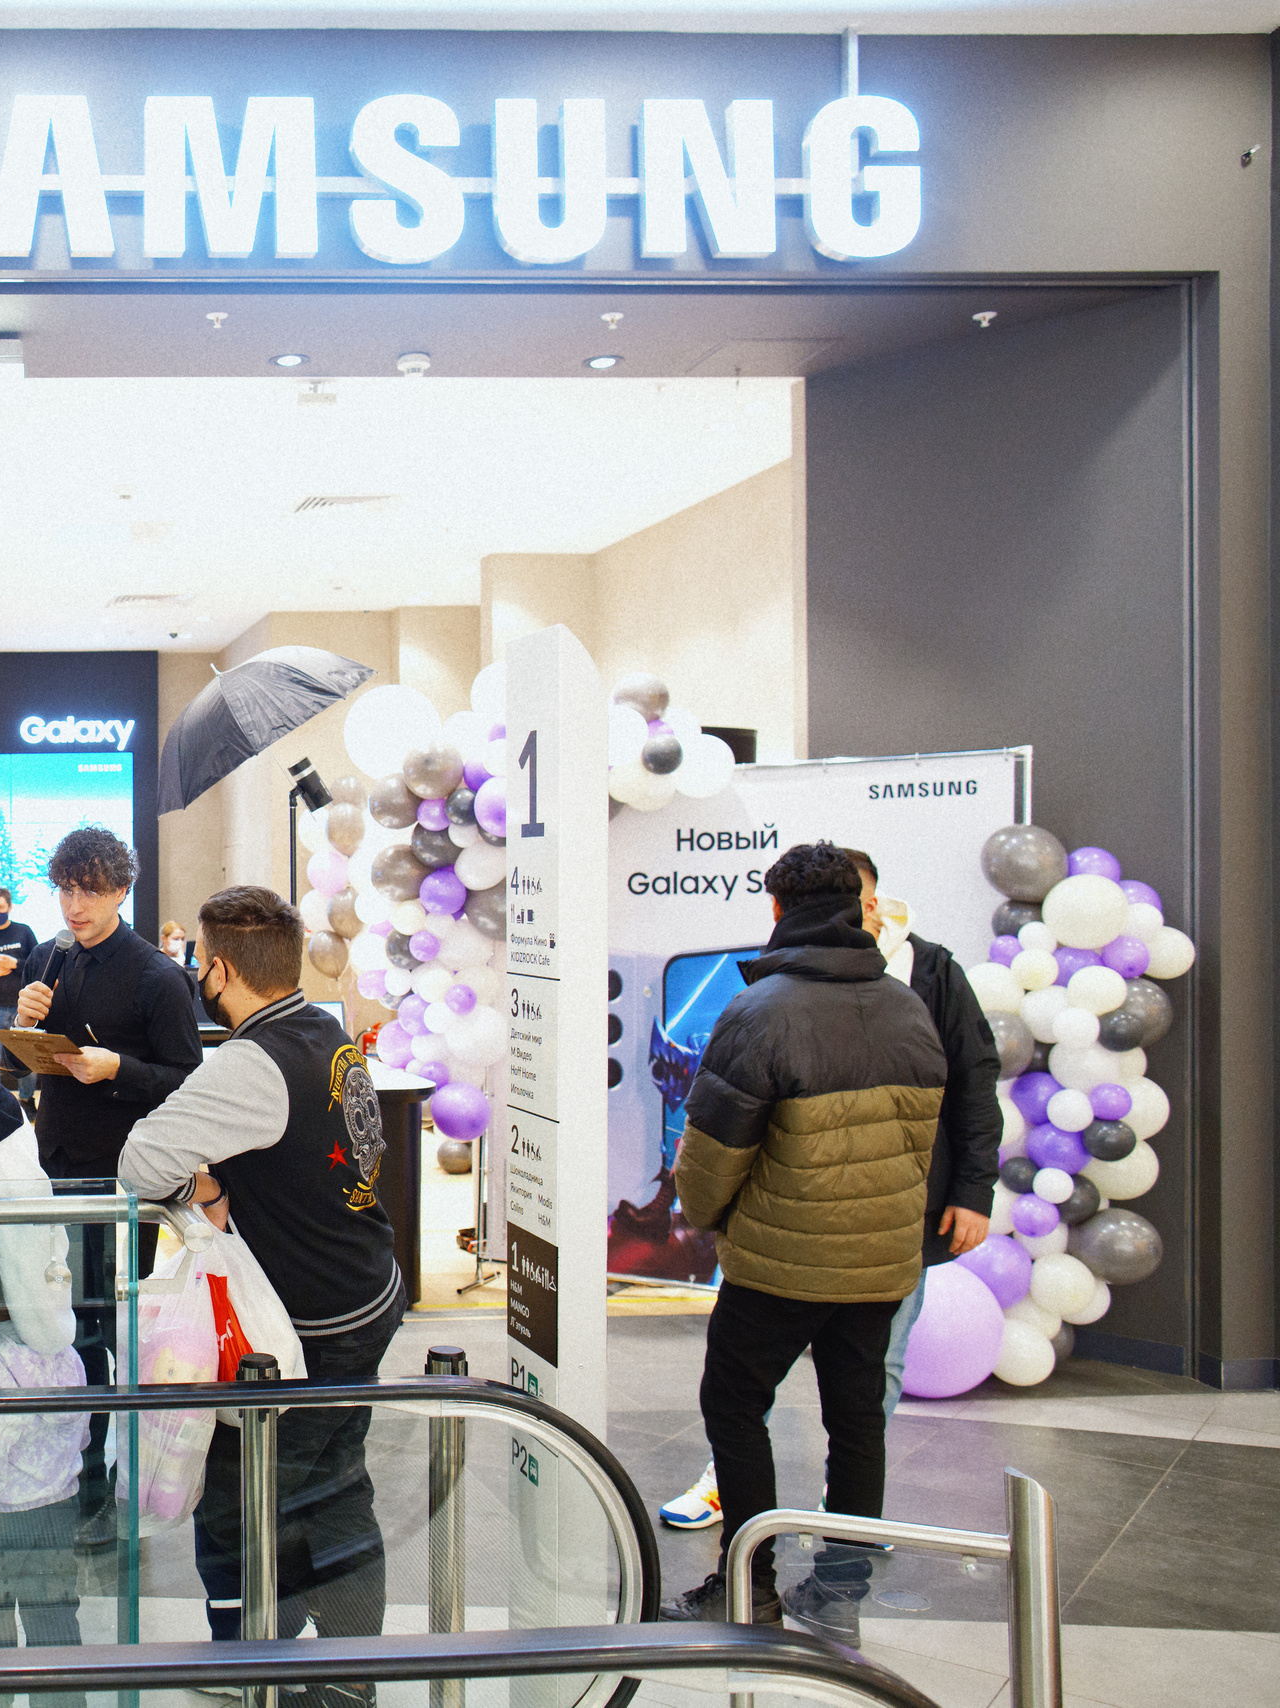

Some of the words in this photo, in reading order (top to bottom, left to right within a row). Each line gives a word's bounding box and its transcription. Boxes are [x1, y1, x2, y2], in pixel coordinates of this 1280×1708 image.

[19, 715, 135, 751] Galaxy
[77, 763, 123, 772] SAMSUNG
[518, 730, 545, 838] 1
[868, 779, 979, 800] SAMSUNG
[675, 822, 779, 852] Новый
[510, 866, 520, 895] 4
[627, 870, 739, 901] Galaxy
[510, 933, 533, 947] Формула
[534, 935, 548, 947] Кино
[538, 954, 551, 966] Cafe
[510, 988, 519, 1018] 3
[510, 1027, 532, 1043] Детский
[532, 1034, 543, 1047] мир
[522, 1068, 537, 1081] Home
[511, 1124, 519, 1155] 2
[511, 1241, 519, 1273] 1
[510, 1279, 523, 1296] H&M
[510, 1297, 530, 1319] MANGO
[511, 1356, 525, 1391] P1
[511, 1437, 528, 1478] P2
